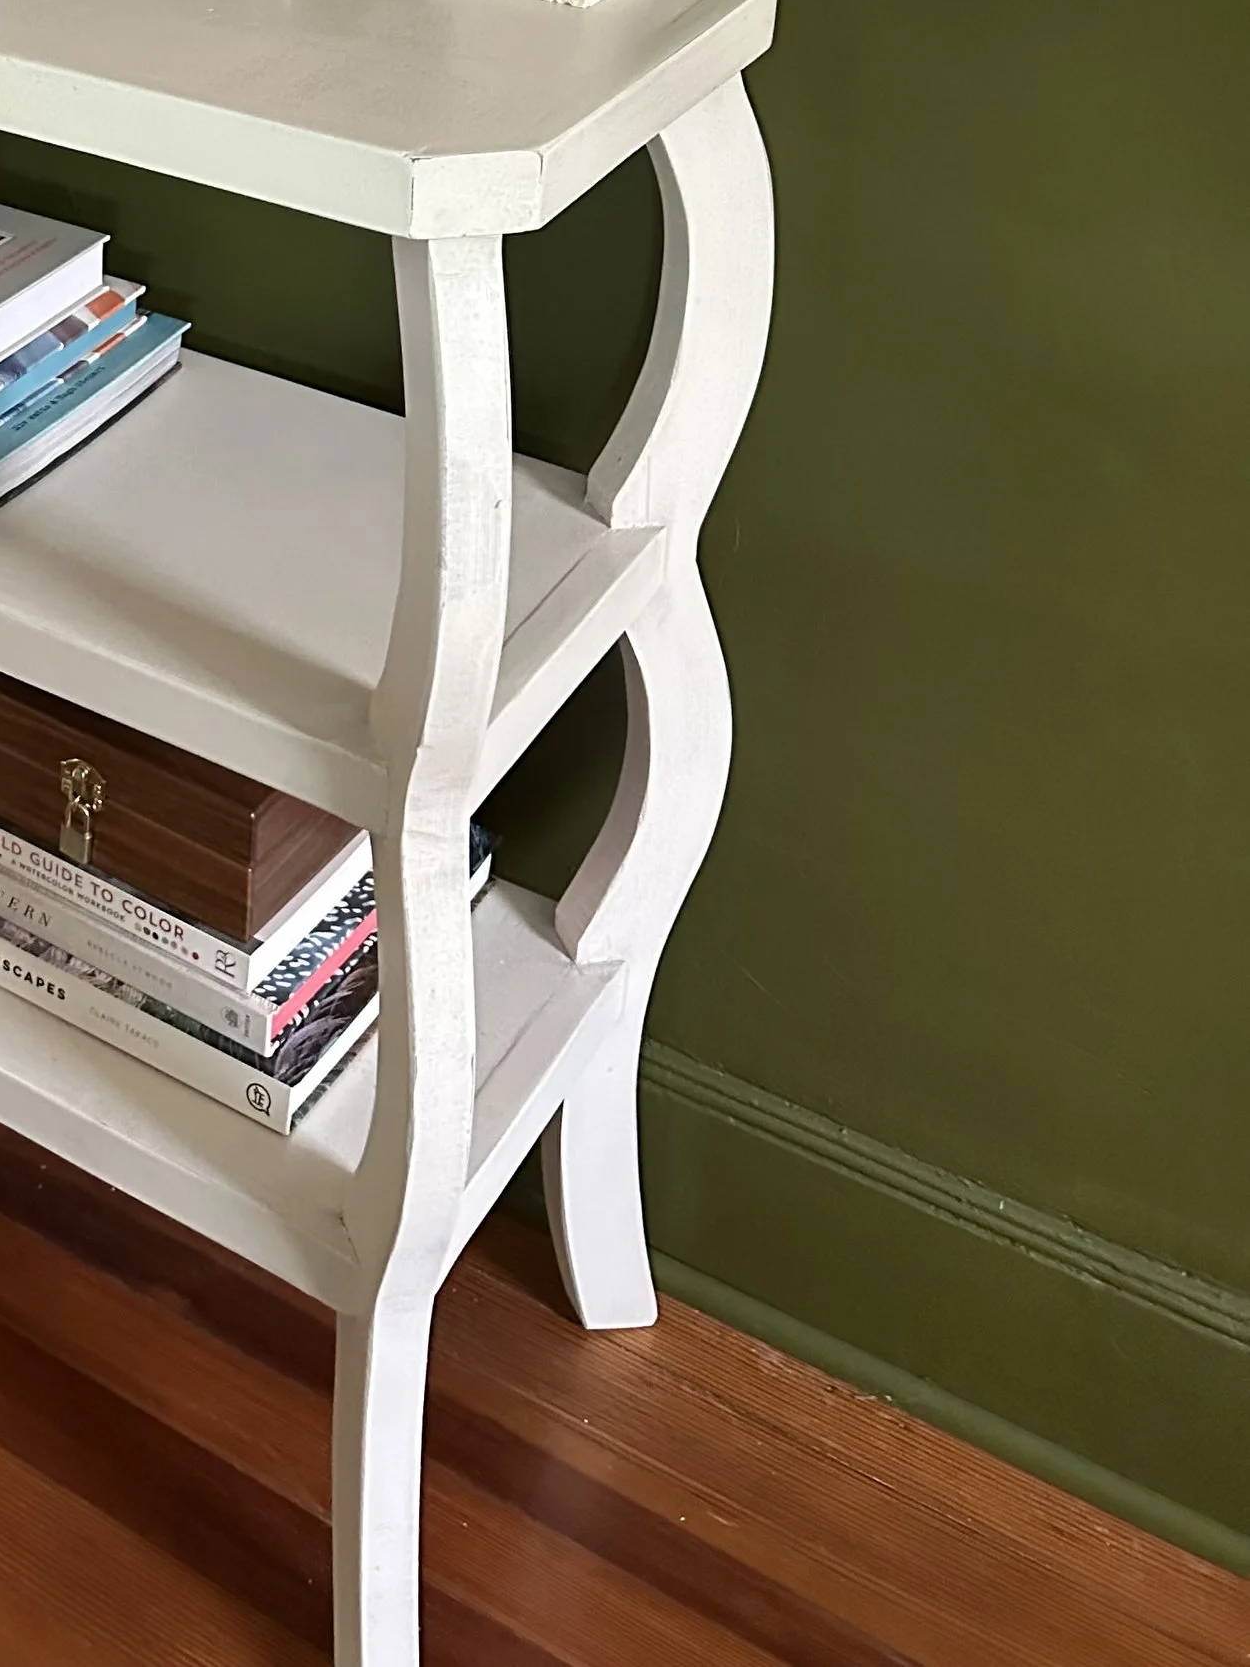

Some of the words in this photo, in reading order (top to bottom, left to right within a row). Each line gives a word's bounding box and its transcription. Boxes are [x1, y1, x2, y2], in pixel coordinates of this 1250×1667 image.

[19, 862, 74, 896] WATERCOLOR
[77, 892, 126, 923] WORKBOOK
[29, 852, 83, 888] GUIDE
[90, 881, 113, 903] TO
[121, 899, 185, 941] COLOR
